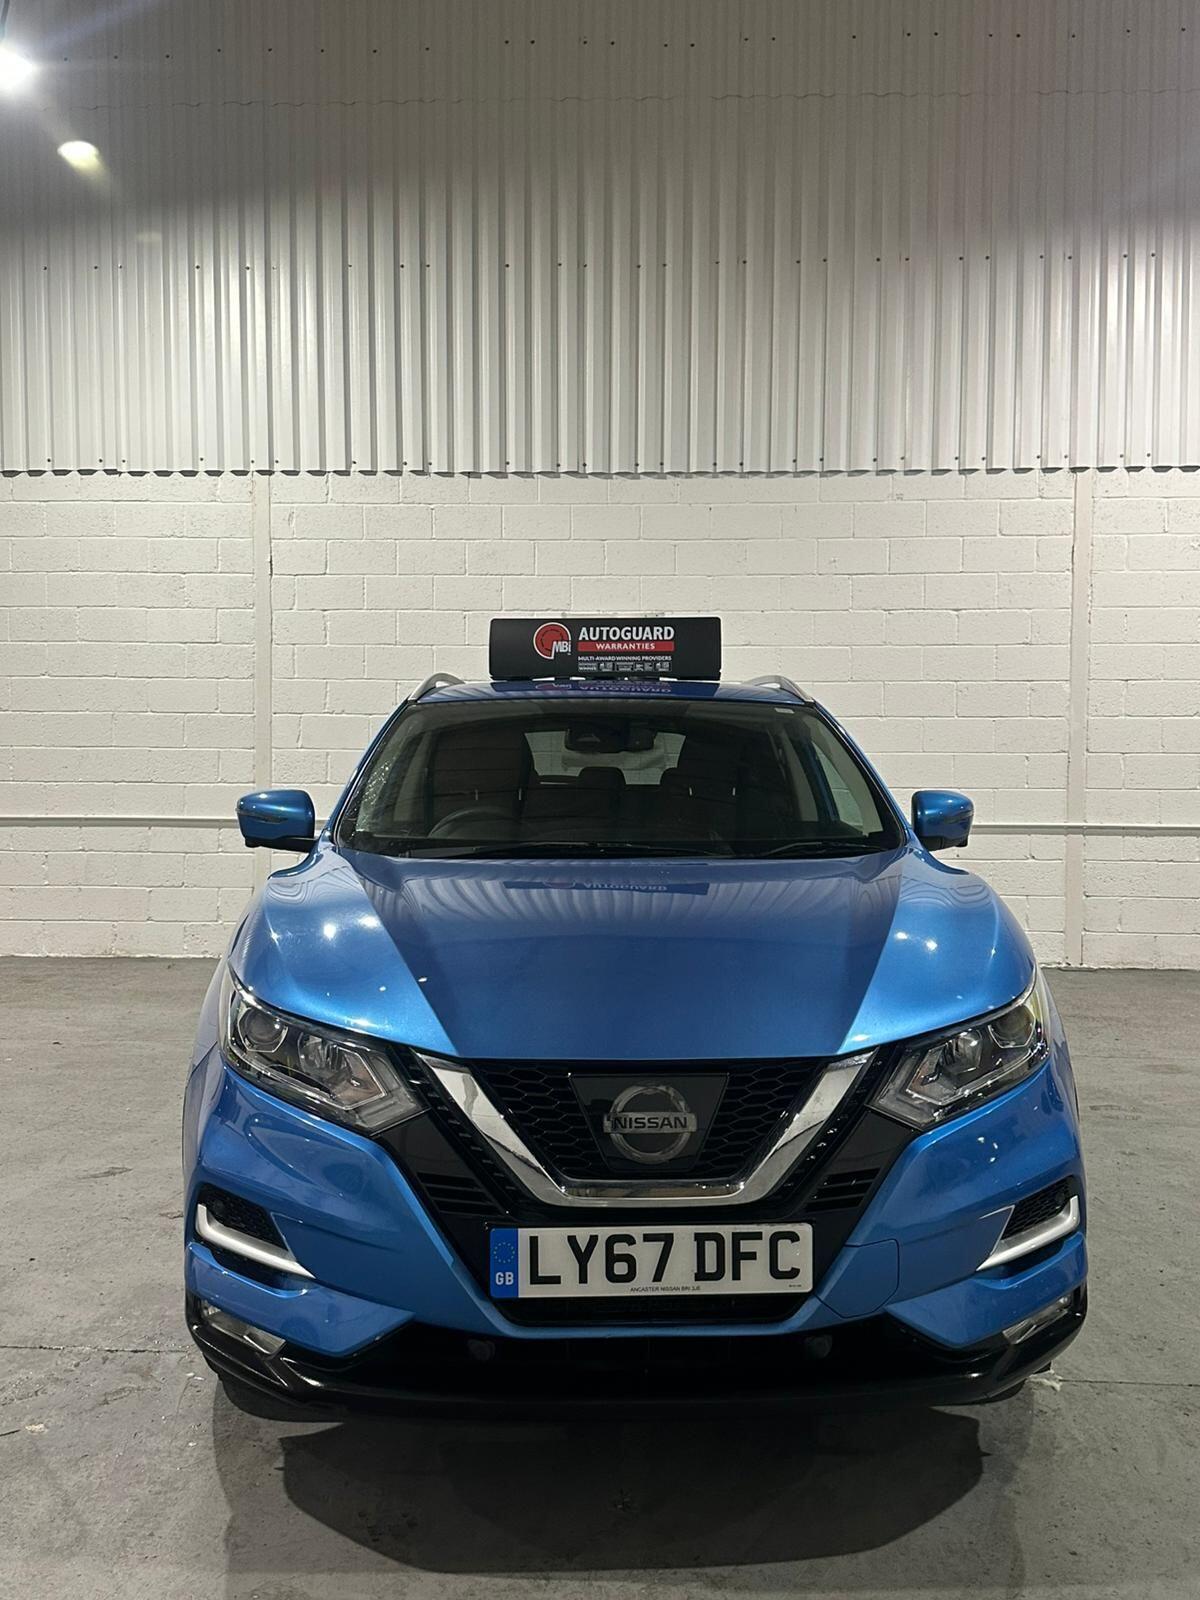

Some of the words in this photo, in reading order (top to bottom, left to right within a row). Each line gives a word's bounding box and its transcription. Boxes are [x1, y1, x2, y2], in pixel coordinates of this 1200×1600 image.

[578, 626, 675, 641] AUTOGUARD
[595, 643, 656, 651] WARRANTIES
[611, 1116, 688, 1129] NISSAN
[529, 1233, 674, 1285] LY67
[693, 1230, 801, 1282] DFC
[495, 1271, 514, 1286] GB
